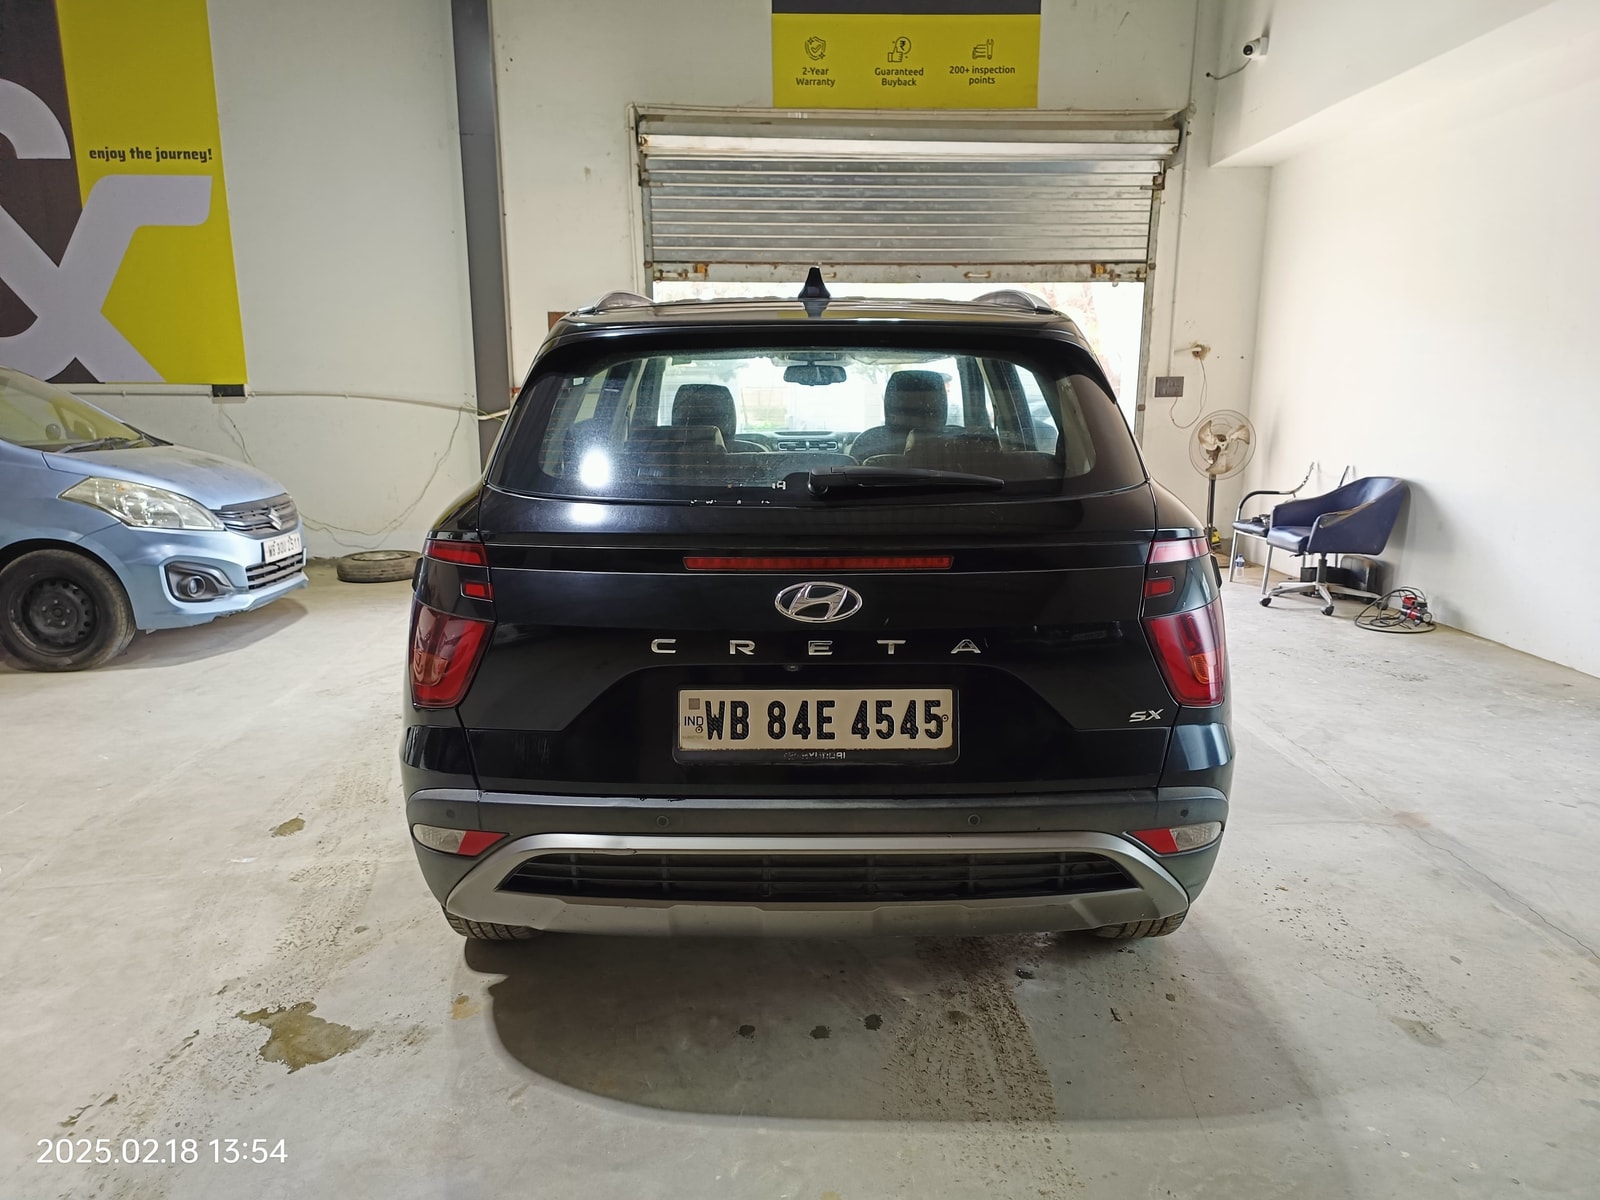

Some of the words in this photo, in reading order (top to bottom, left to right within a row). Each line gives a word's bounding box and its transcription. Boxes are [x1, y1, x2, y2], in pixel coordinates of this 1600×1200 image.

[802, 67, 829, 76] 2-Year
[874, 67, 924, 76] Guaranteed
[949, 65, 970, 75] 200+
[971, 65, 1016, 76] inspection
[795, 77, 836, 88] Warranty
[881, 77, 917, 88] Buyback
[968, 76, 996, 86] points
[89, 146, 126, 162] enjoy
[129, 146, 152, 160] the
[155, 146, 213, 163] journey!
[650, 638, 982, 656] CRETA
[684, 715, 704, 726] IND
[705, 700, 749, 740] WB
[767, 700, 836, 740] 84E
[851, 700, 943, 740] 4545
[1128, 709, 1164, 722] SX
